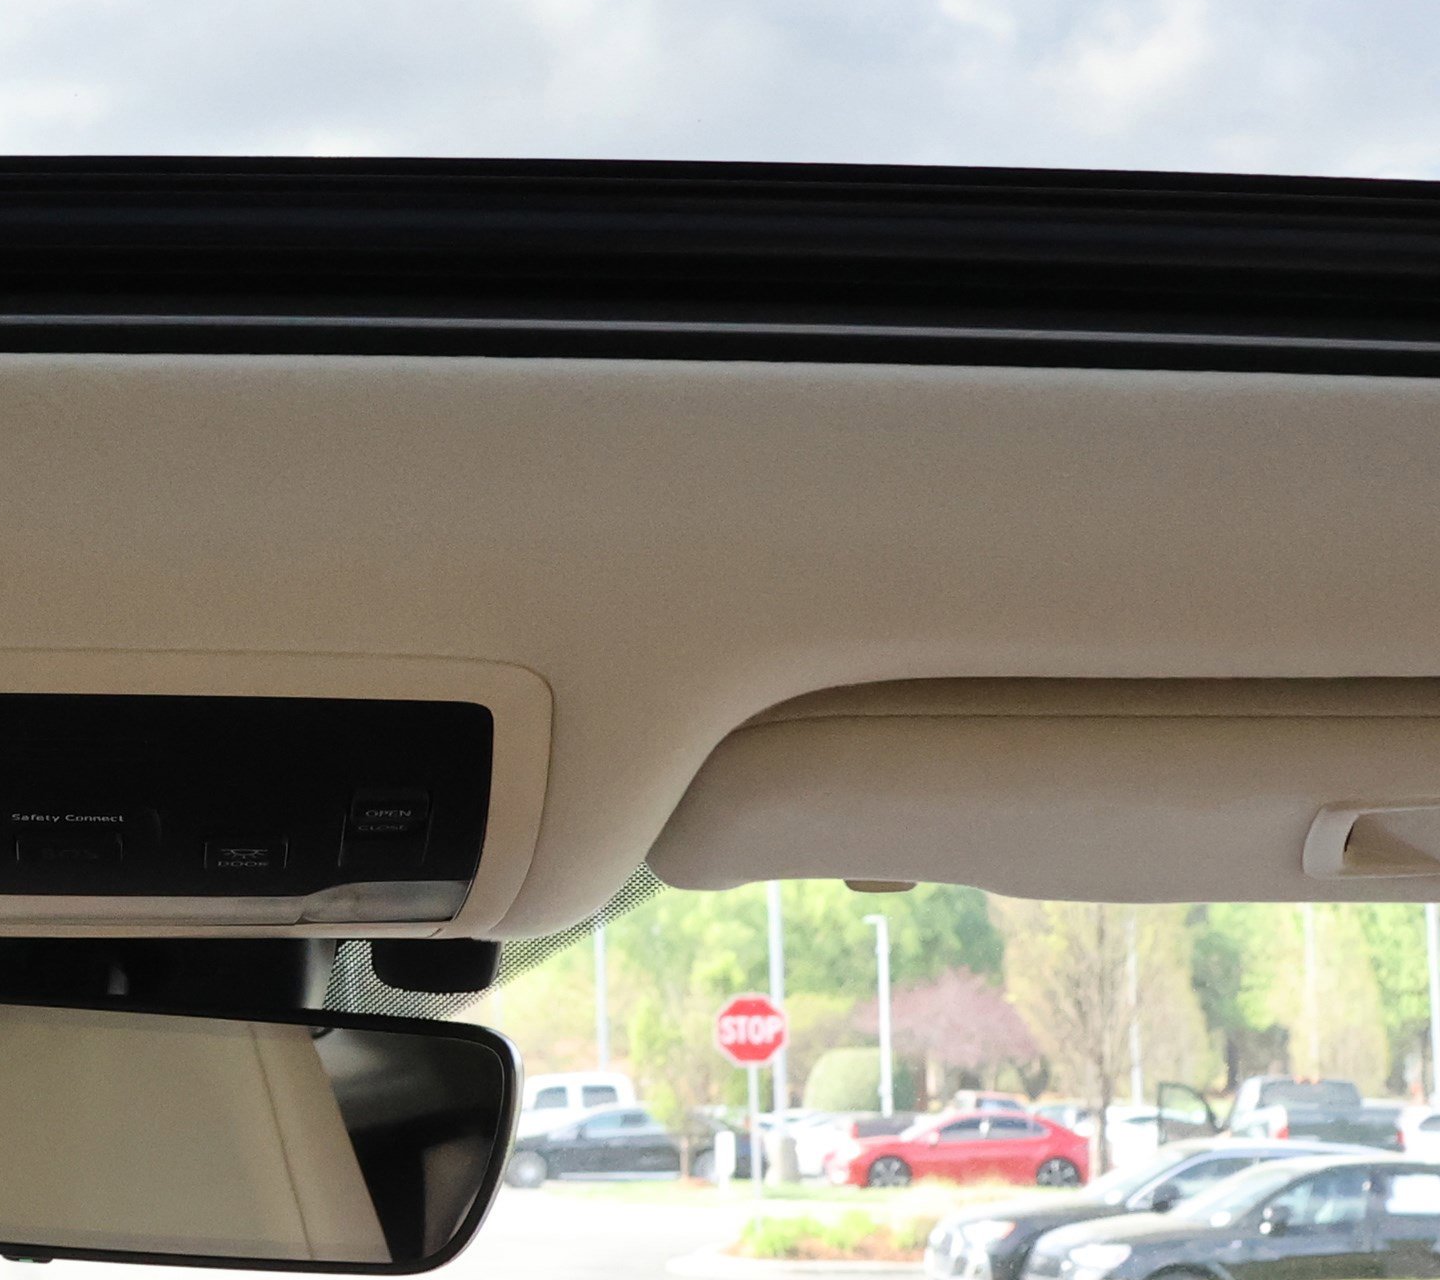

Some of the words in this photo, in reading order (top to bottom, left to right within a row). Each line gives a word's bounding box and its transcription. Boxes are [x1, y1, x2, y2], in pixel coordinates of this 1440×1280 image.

[11, 813, 60, 824] Safety
[65, 814, 125, 823] Connect
[365, 809, 412, 818] OPEN
[358, 824, 408, 832] CLOSE
[720, 1015, 784, 1045] STOP
